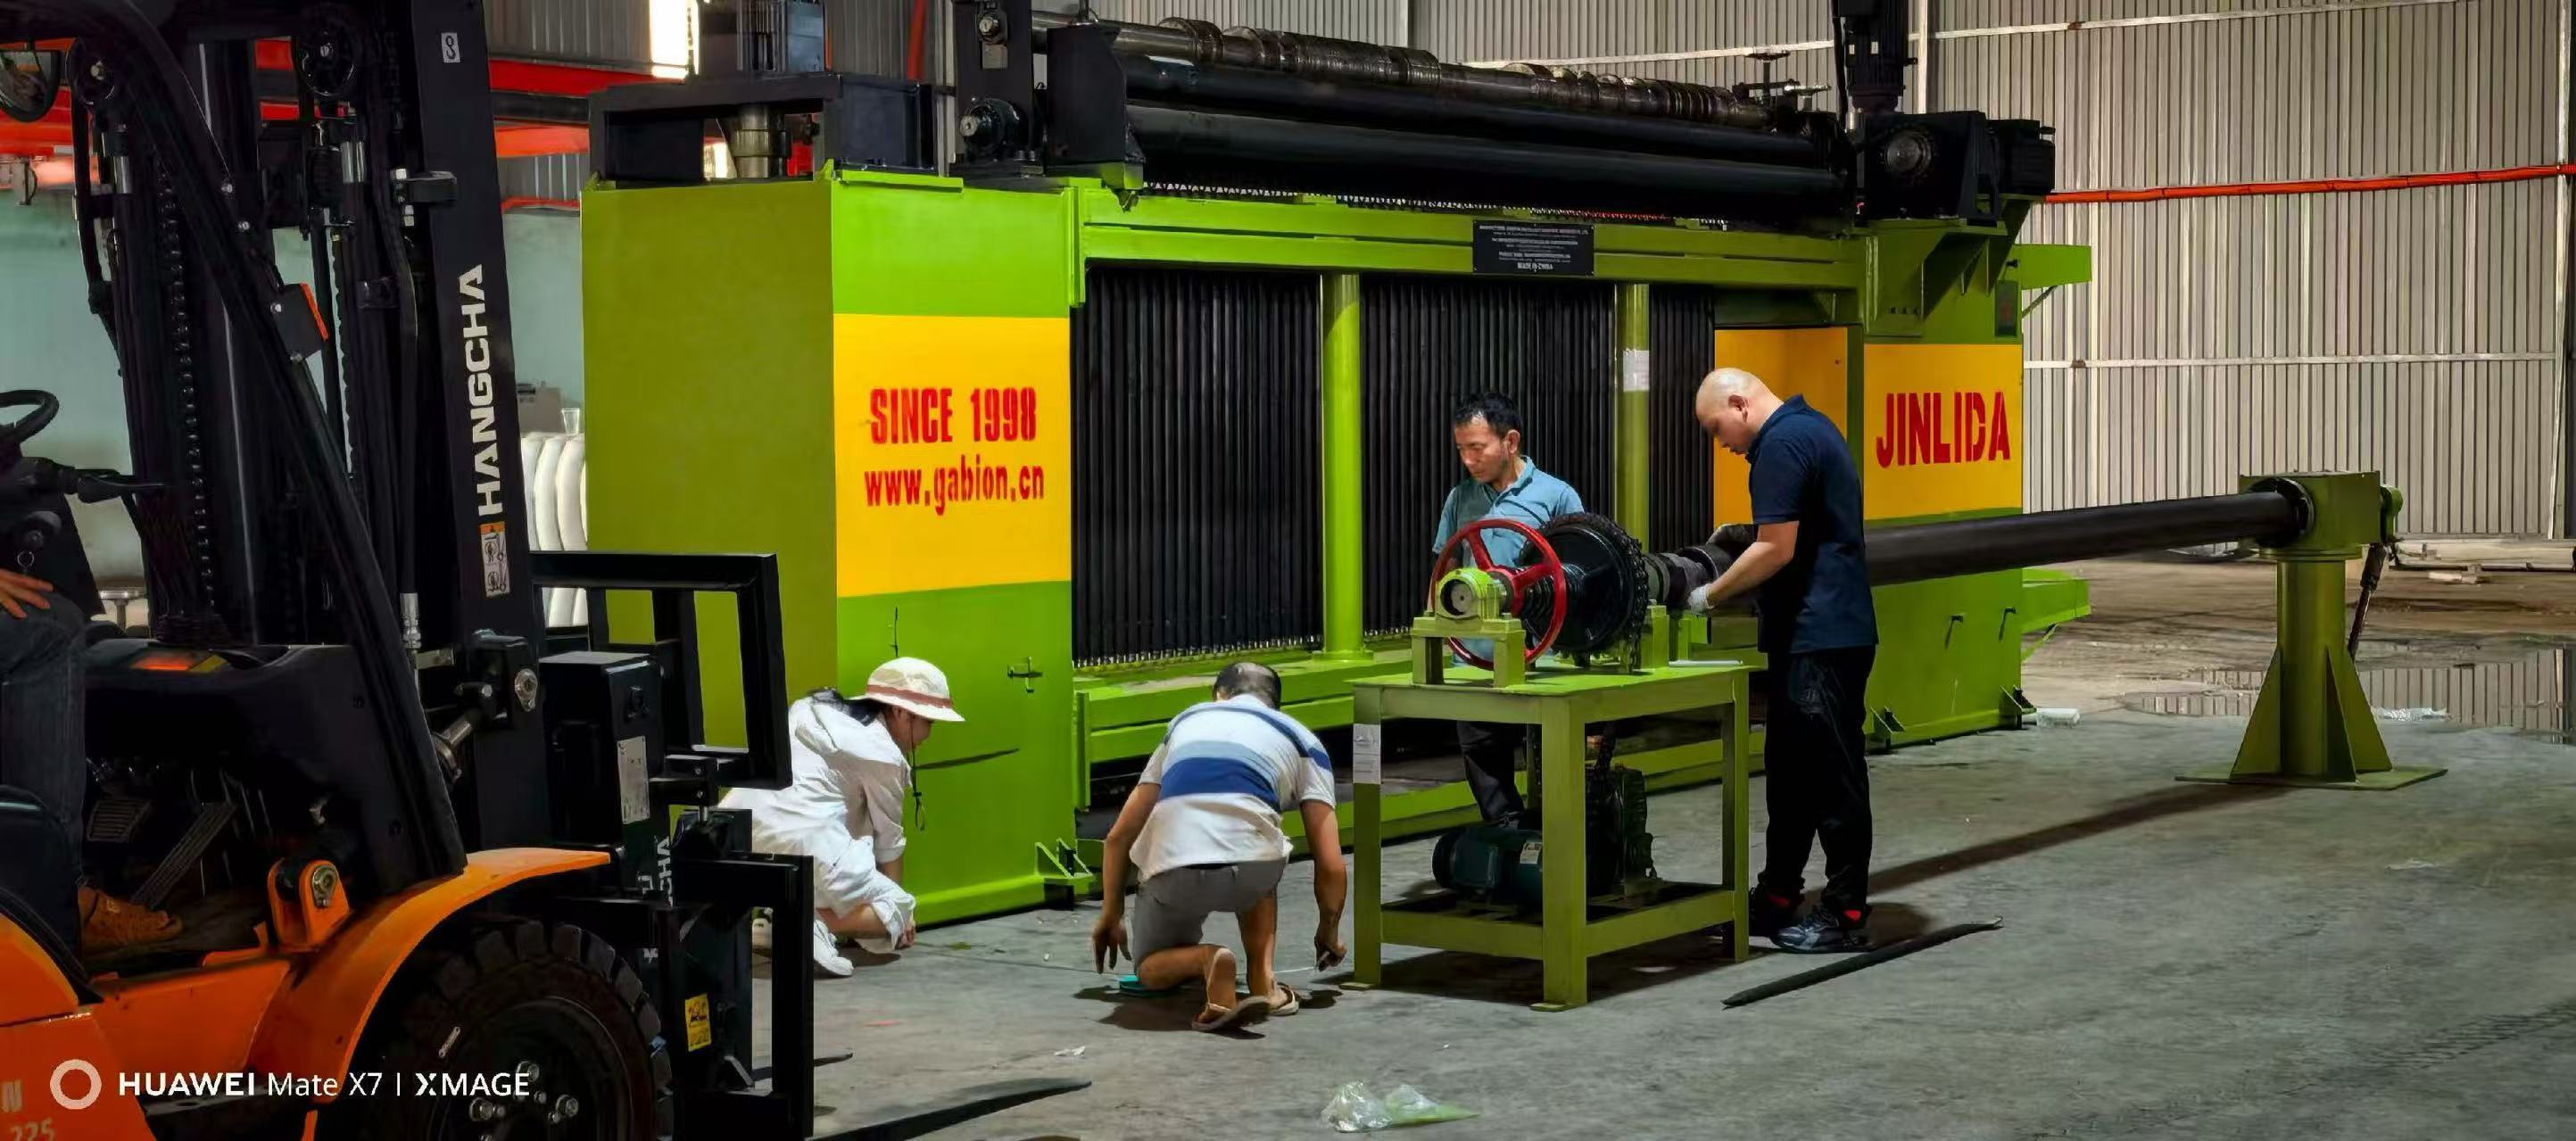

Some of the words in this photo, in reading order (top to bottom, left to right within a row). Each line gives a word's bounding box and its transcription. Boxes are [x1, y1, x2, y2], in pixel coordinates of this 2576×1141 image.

[459, 264, 503, 517] HANGCHA
[870, 387, 953, 444] SINCE
[970, 387, 1037, 442] 1998
[1876, 391, 2011, 469] JINLIDA
[864, 454, 1044, 517] www.gabion.cn
